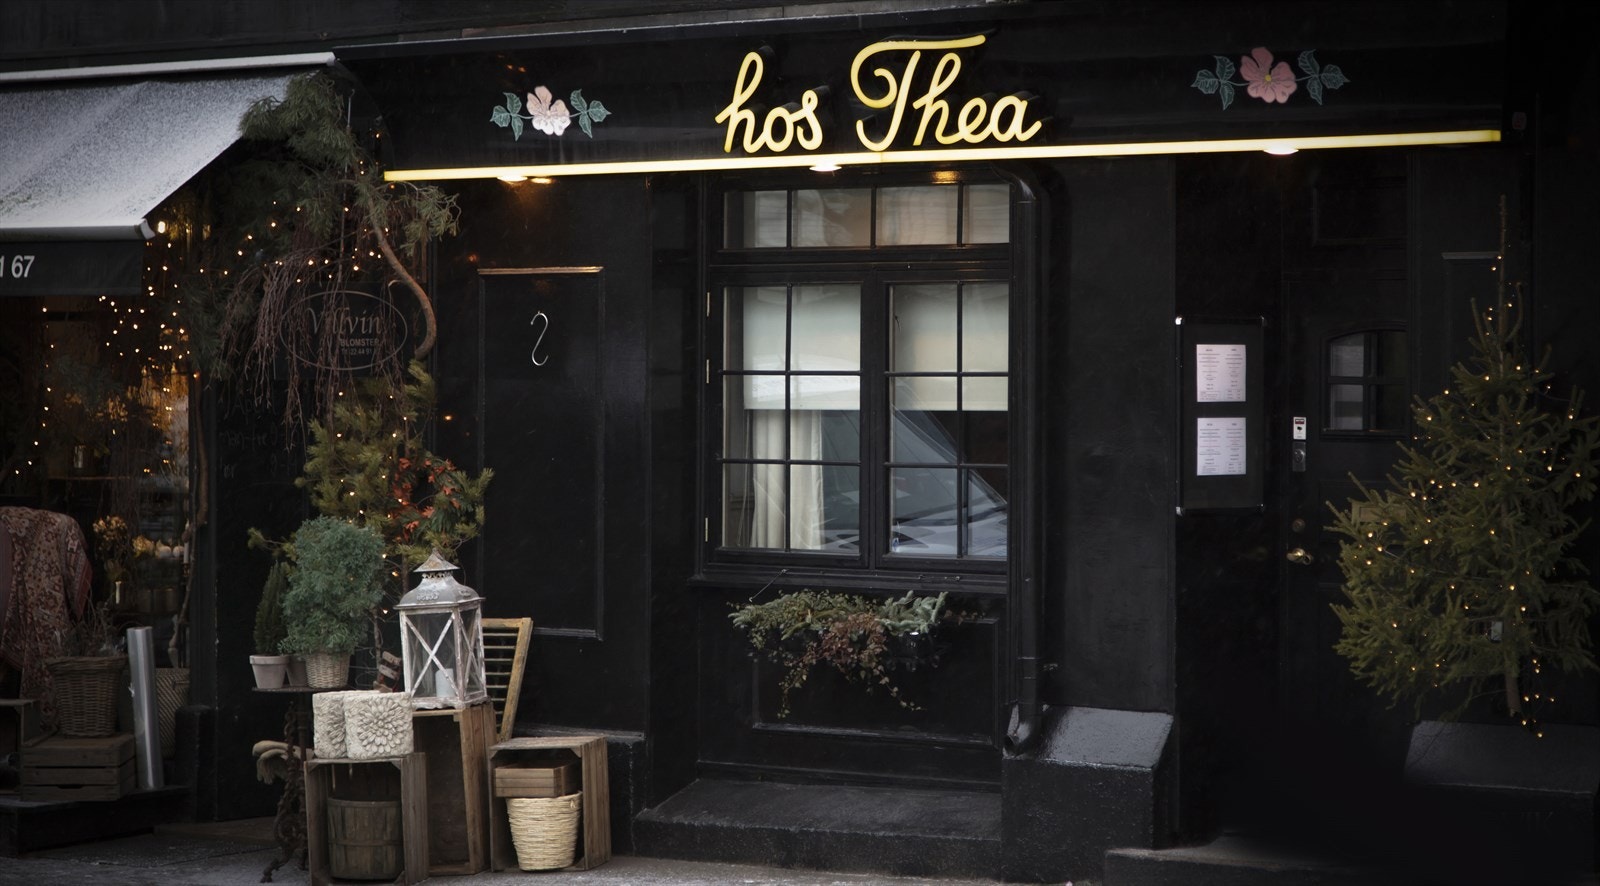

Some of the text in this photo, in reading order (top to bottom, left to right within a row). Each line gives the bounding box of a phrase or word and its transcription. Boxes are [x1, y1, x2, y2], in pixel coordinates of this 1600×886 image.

[714, 34, 1042, 153] hos Thea
[11, 254, 35, 279] 67
